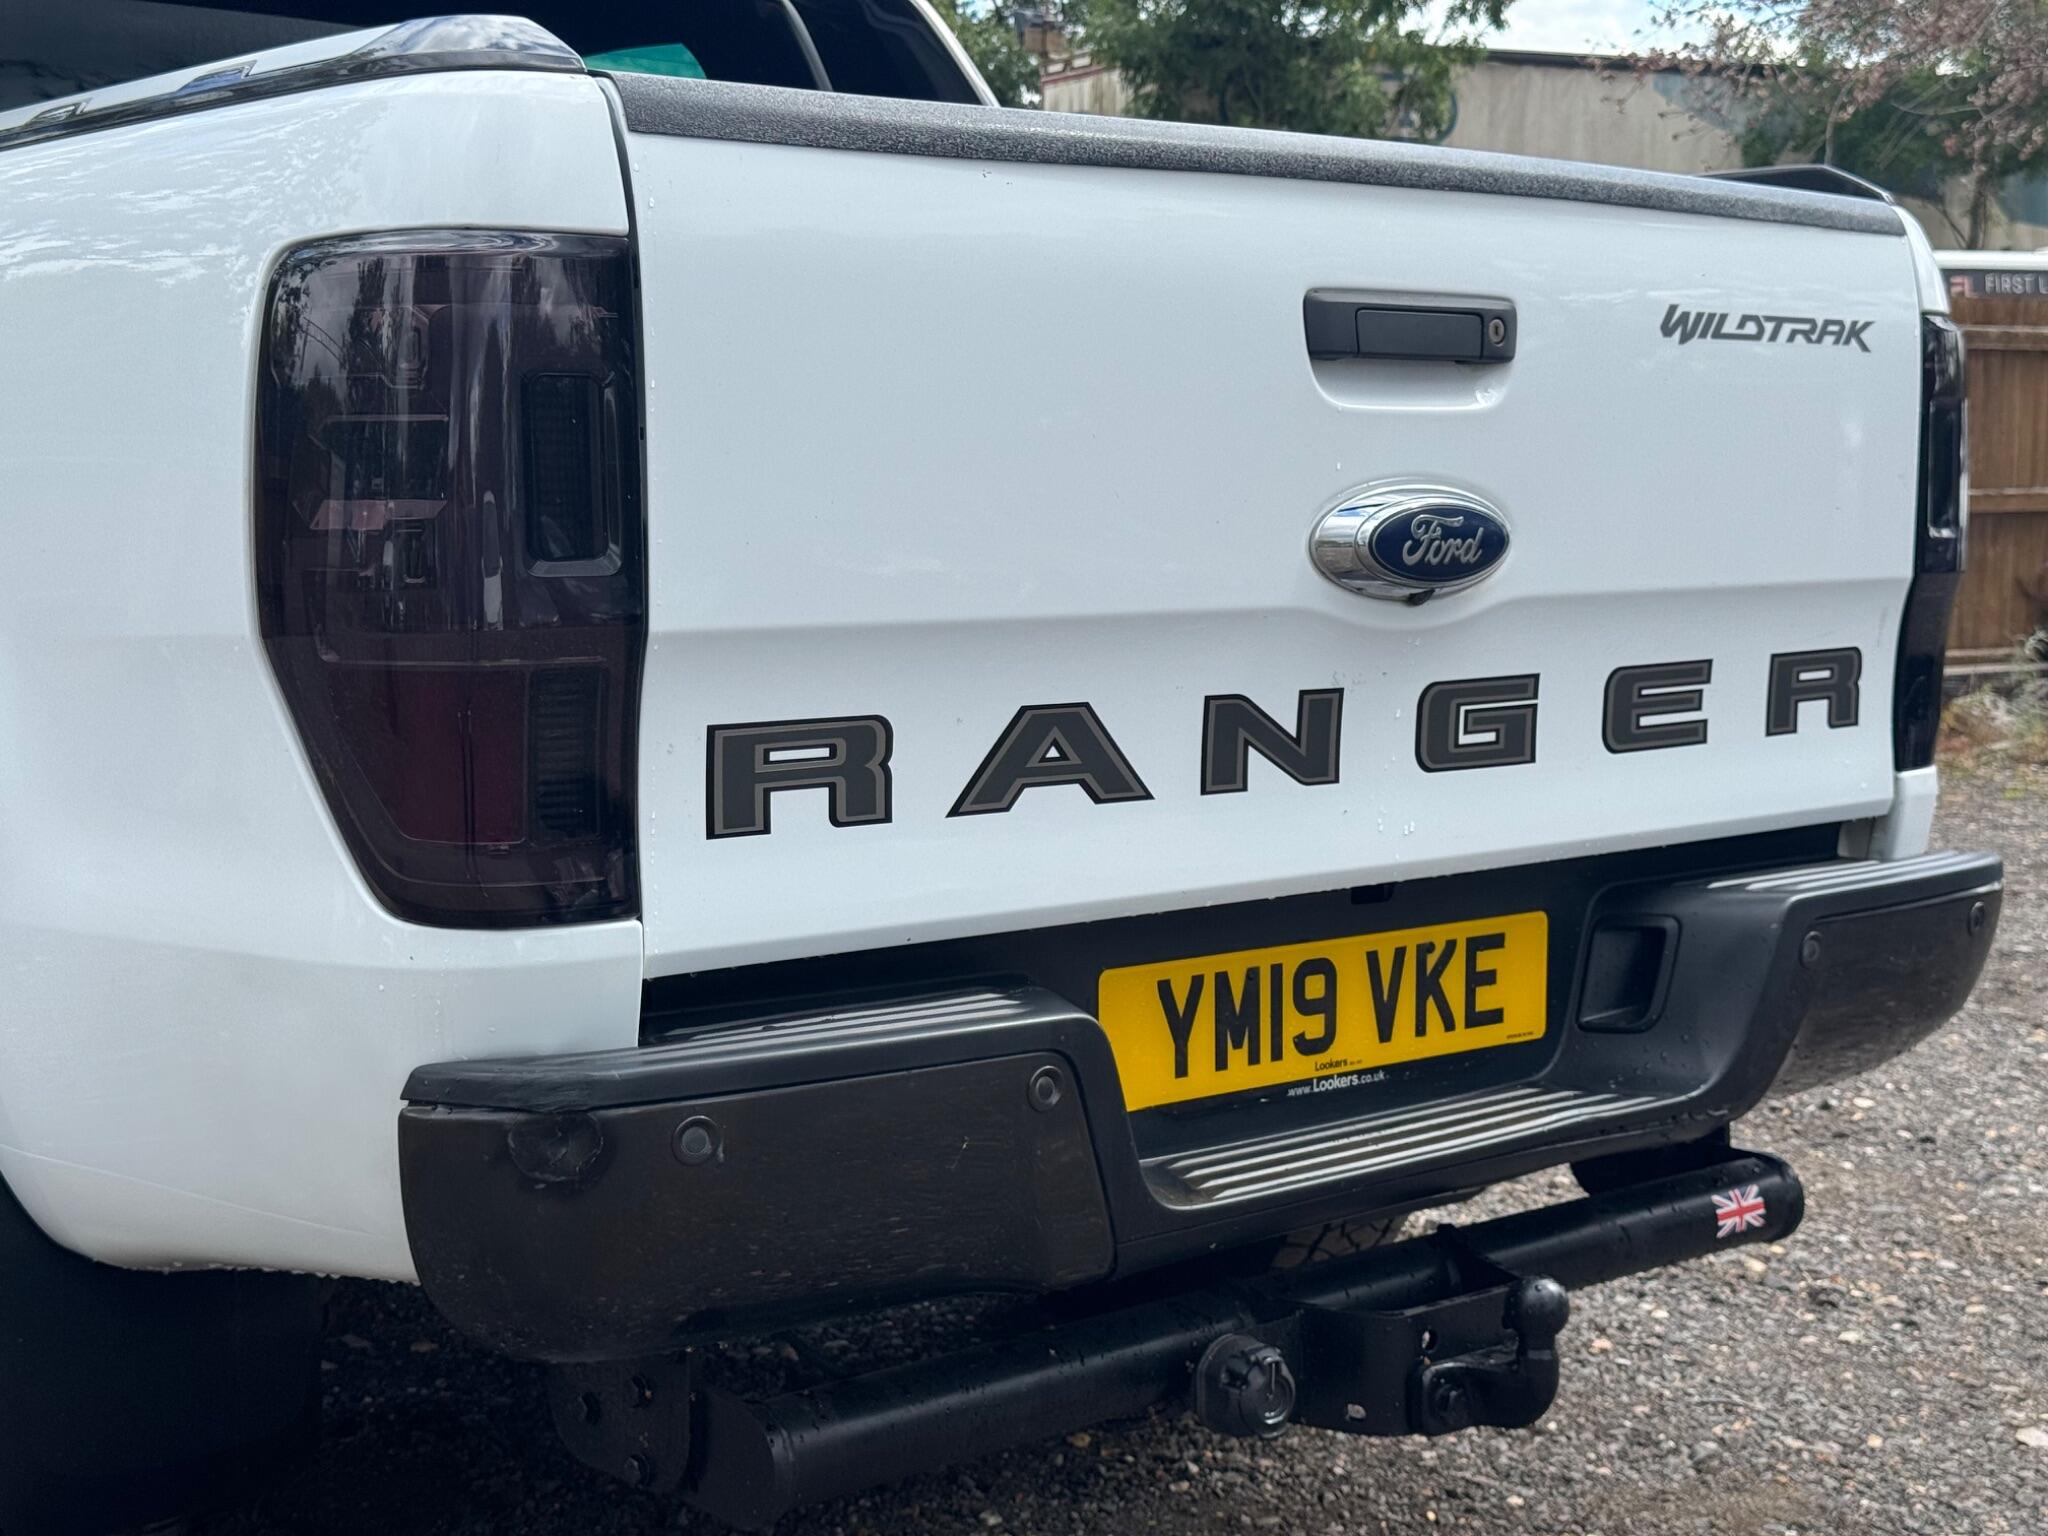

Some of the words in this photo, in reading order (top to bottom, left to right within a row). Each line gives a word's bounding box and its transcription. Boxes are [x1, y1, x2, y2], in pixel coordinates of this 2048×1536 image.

[1985, 272, 2035, 295] FIRST
[1660, 304, 1876, 353] WILDTRAK
[1402, 514, 1484, 566] Ford
[705, 646, 1862, 839] RANGER
[1156, 956, 1338, 1079] YM19
[1366, 932, 1506, 1044] VKE
[1287, 1070, 1386, 1096] www.Lookers.co.uk
[1315, 1058, 1348, 1071] Lookers
